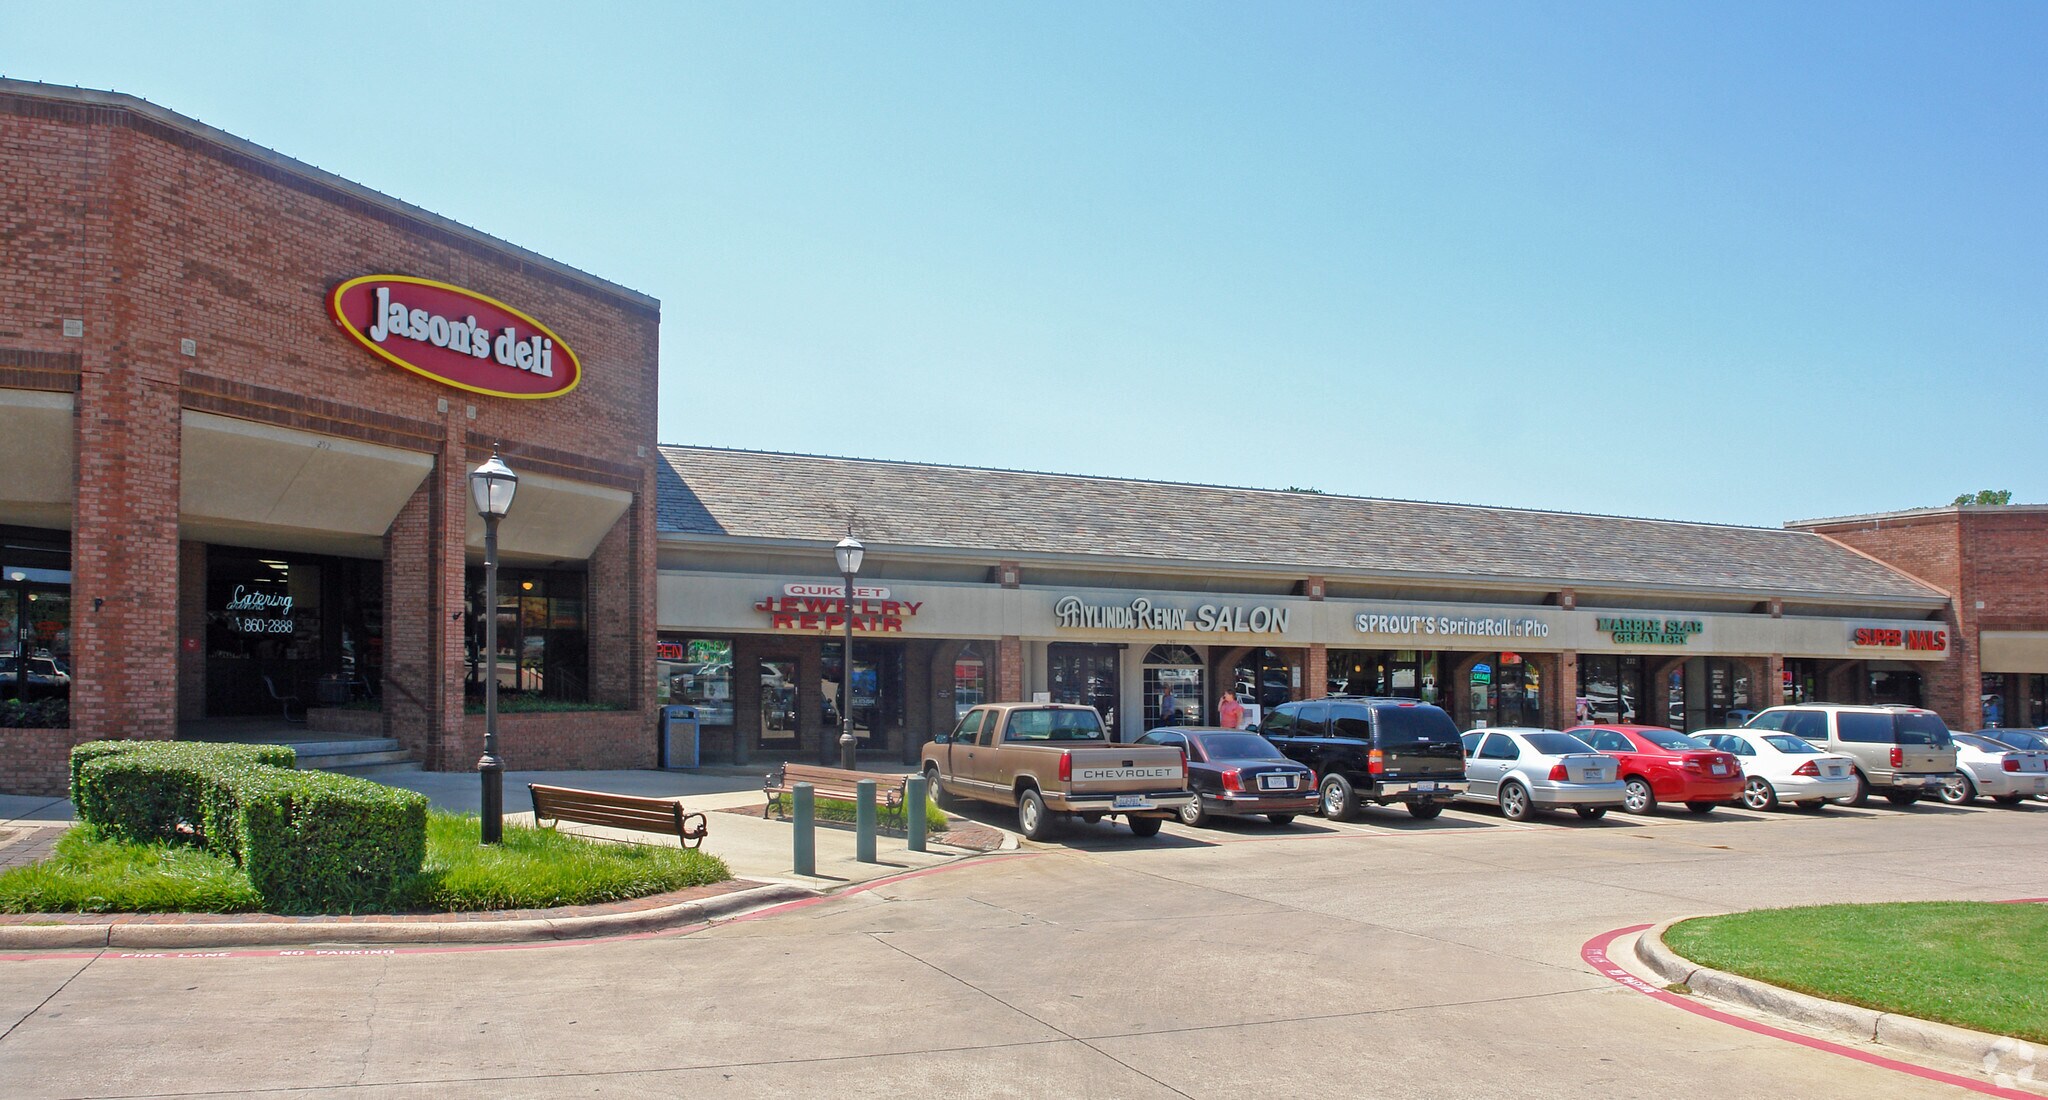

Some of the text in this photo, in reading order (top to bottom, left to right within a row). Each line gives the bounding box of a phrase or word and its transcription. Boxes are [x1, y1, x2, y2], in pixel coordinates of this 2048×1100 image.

[369, 287, 553, 378] Jason's deli
[234, 584, 293, 615] Catering
[790, 585, 841, 596] QUIK
[755, 597, 923, 616] JEWELRY
[244, 618, 293, 634] 860-2888
[772, 614, 903, 632] REPAIR
[1194, 604, 1290, 634] SALON
[1356, 613, 1436, 635] SPROUT'S
[1439, 616, 1511, 637] SpringRoll
[1524, 619, 1549, 638] Pho
[1597, 617, 1704, 634] MARBLE SLAB
[1613, 632, 1688, 645] CREAMERY
[1856, 628, 1902, 647] SUPER
[656, 644, 681, 659] PEN
[1083, 768, 1173, 779] CHEVROLET
